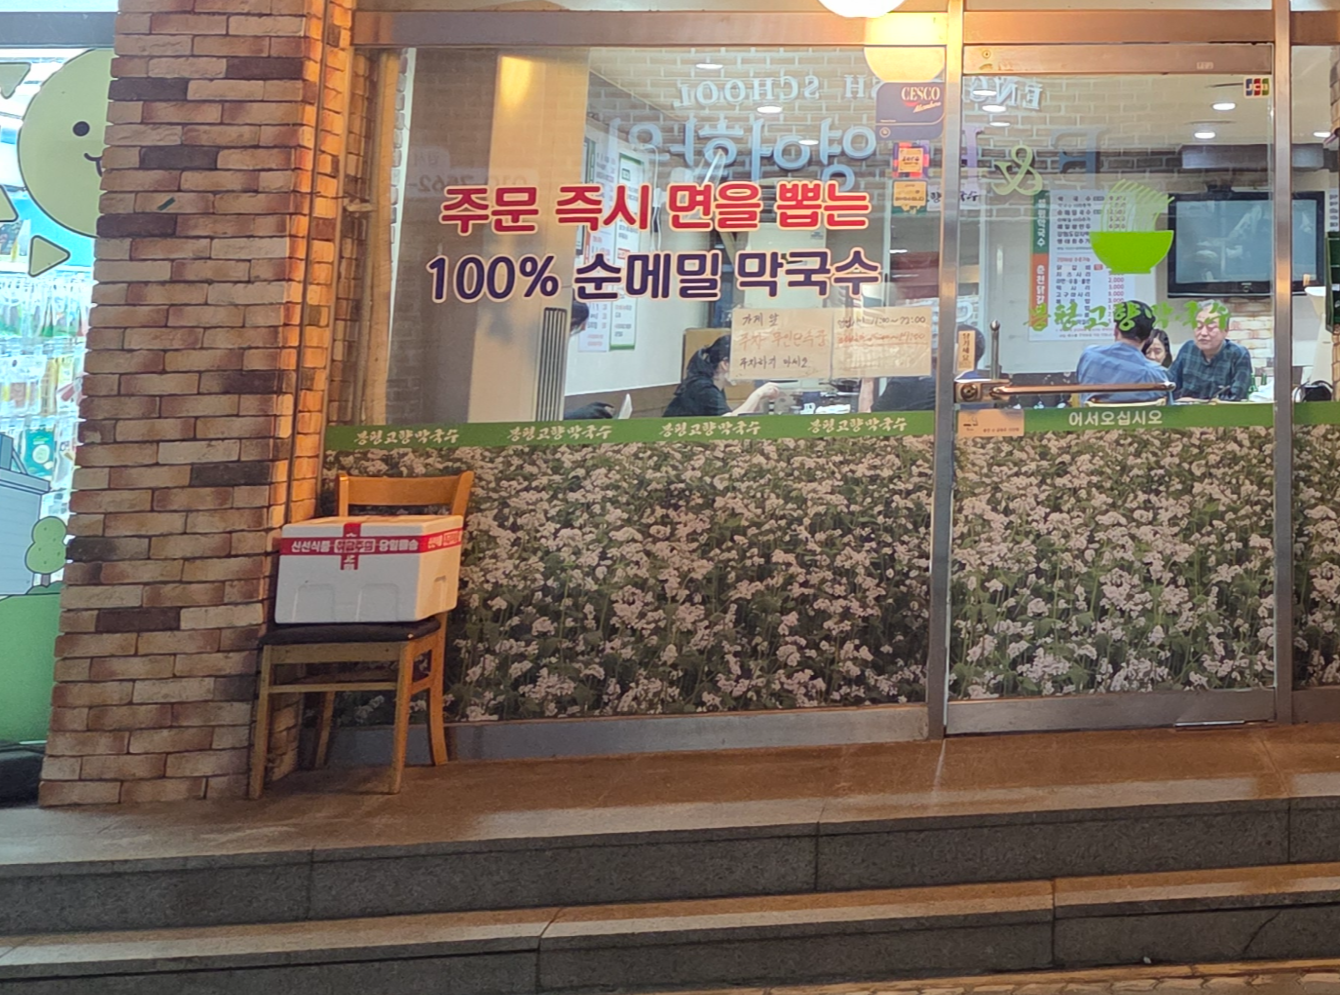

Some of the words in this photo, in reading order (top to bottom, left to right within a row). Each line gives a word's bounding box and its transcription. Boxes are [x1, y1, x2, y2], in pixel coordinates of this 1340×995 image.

[901, 86, 940, 101] CESCO
[440, 185, 540, 235] 주문
[554, 183, 650, 232] 즉시
[668, 182, 762, 231] 면을
[775, 180, 871, 229] 뽑는
[427, 254, 561, 303] 100%
[574, 250, 722, 301] 순메밀
[736, 246, 882, 299] 막국수
[962, 332, 971, 362] 당기세요
[1068, 409, 1163, 427] 어서오십시오
[291, 539, 331, 553] 신선식품
